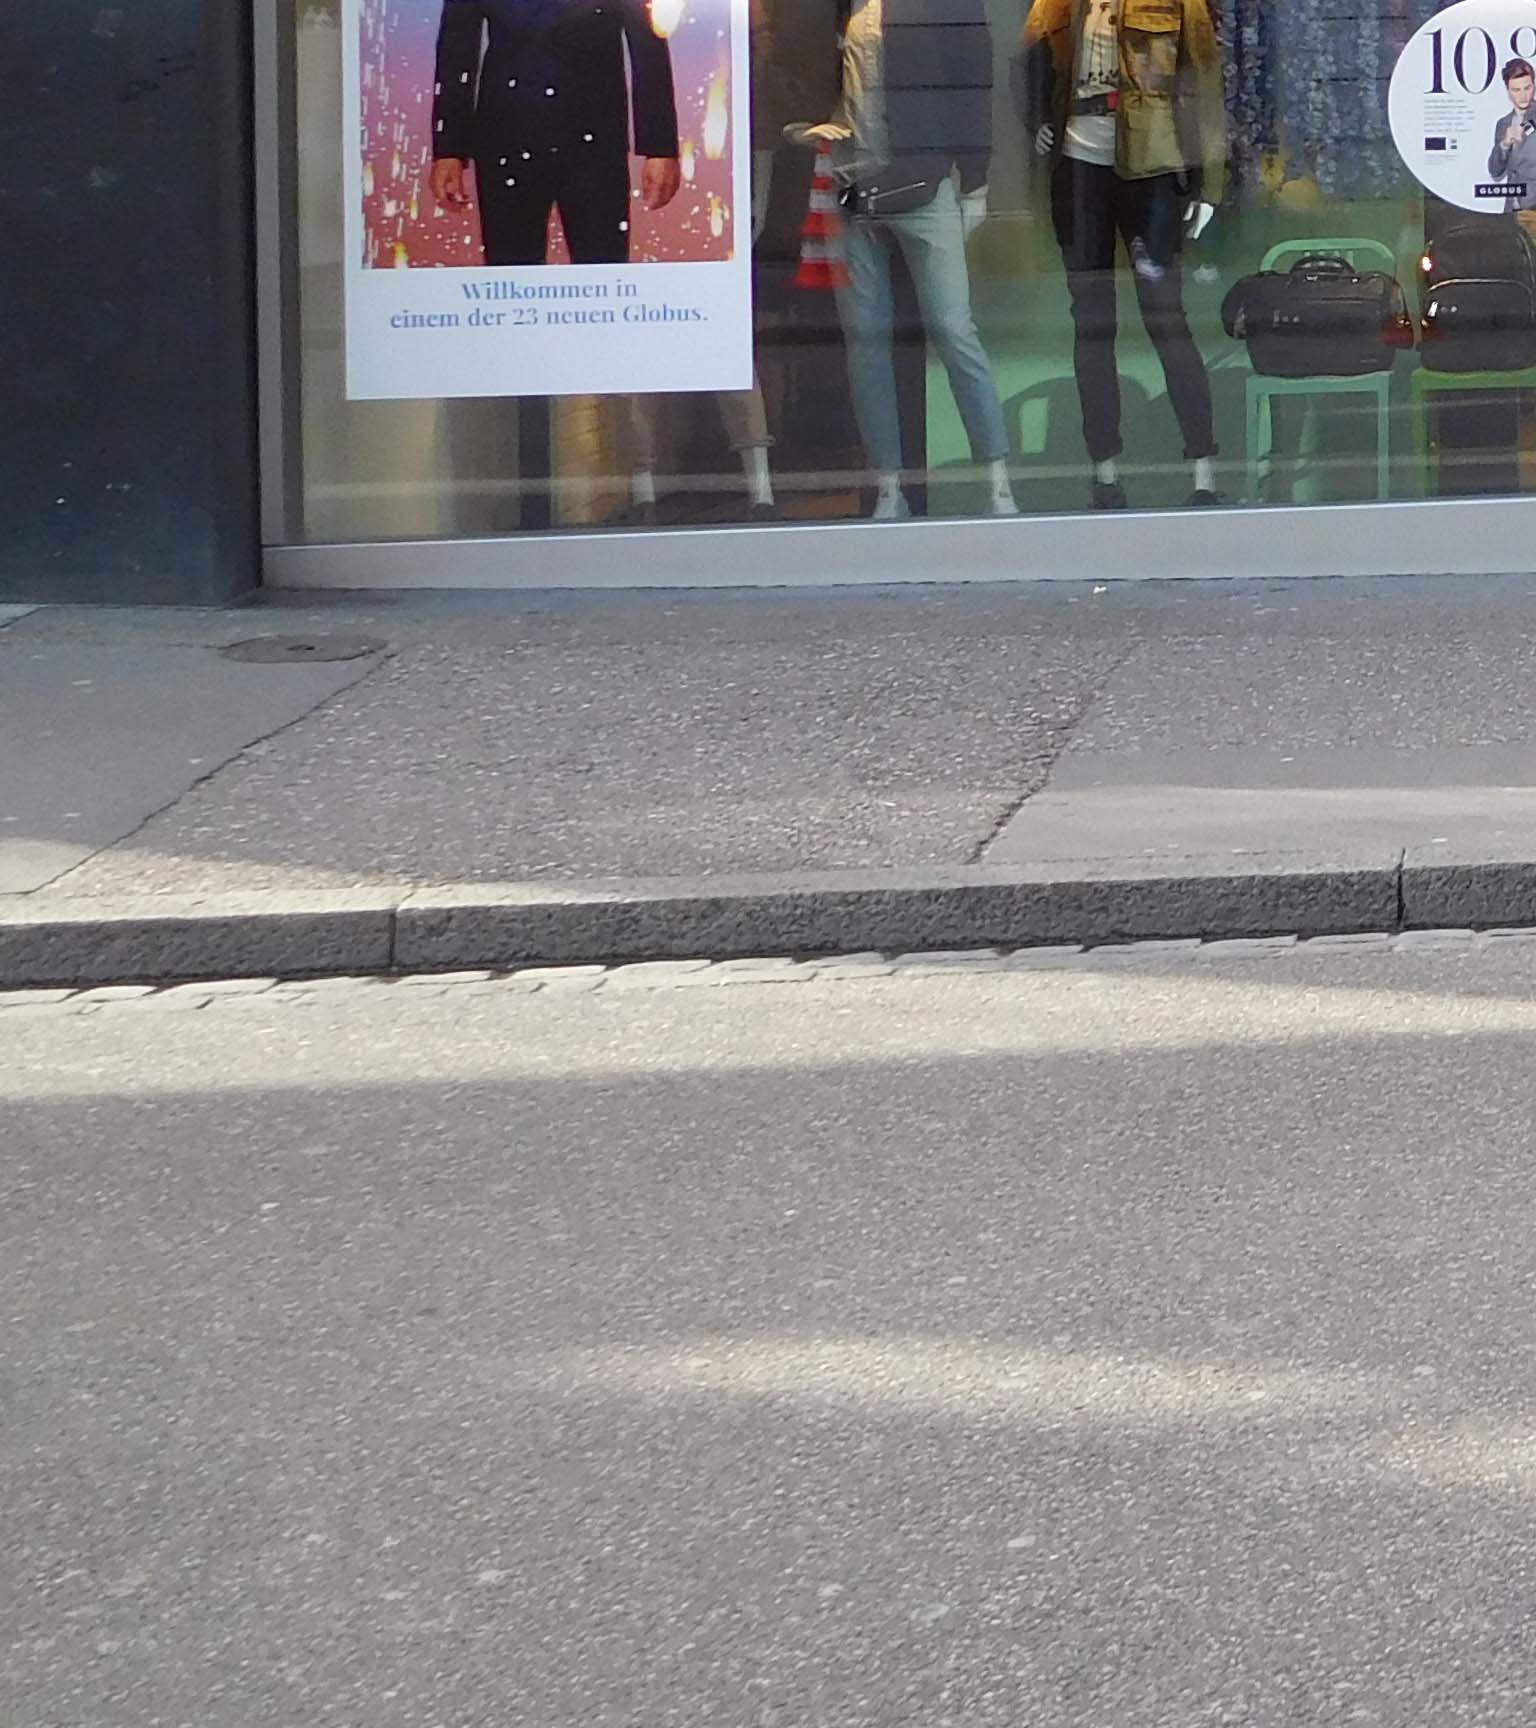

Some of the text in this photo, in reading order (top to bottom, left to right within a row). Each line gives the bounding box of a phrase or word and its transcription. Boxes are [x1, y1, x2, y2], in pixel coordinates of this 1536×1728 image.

[1479, 186, 1523, 195] GLOBUS
[461, 278, 638, 301] Willkommen in
[389, 303, 709, 329] einem der 23 neuen Globus.
